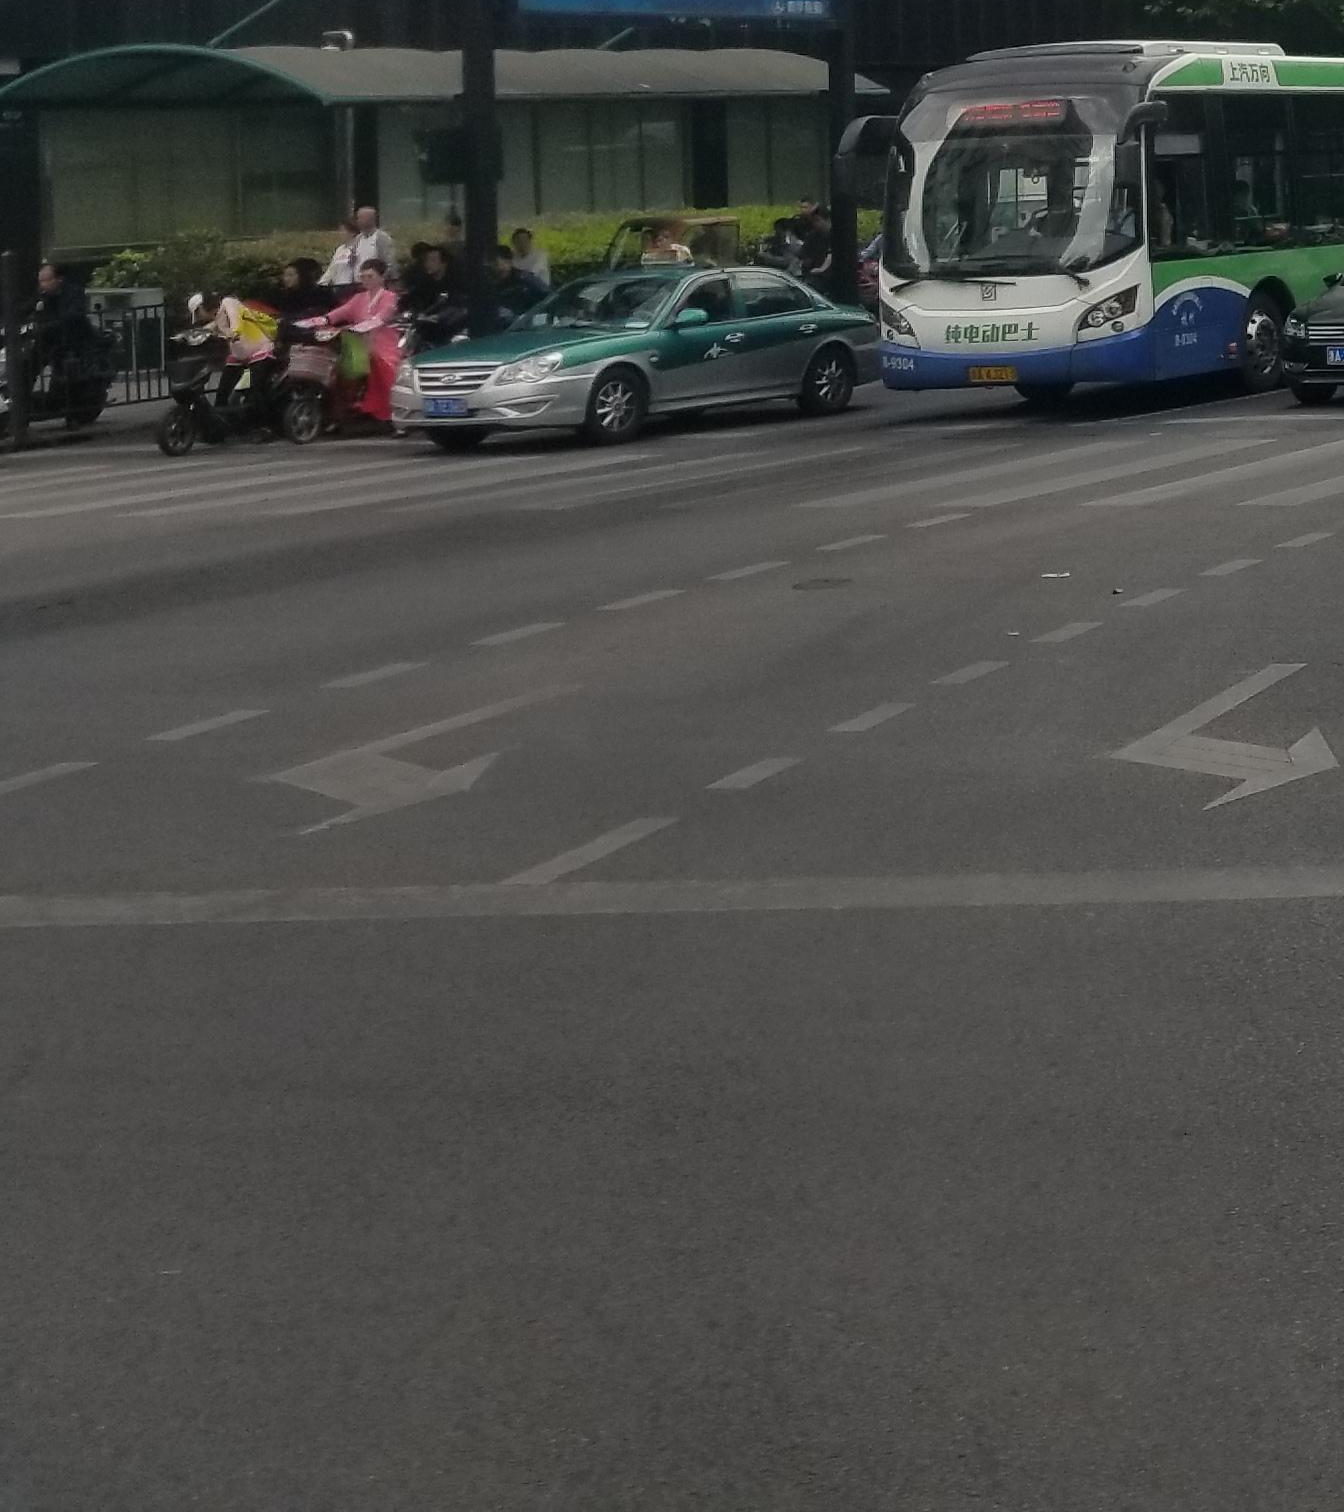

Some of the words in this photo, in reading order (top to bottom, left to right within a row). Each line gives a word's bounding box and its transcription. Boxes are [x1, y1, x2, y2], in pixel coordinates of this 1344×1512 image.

[1230, 61, 1270, 83] 上汽万向
[944, 321, 1040, 344] 纯电动巴士
